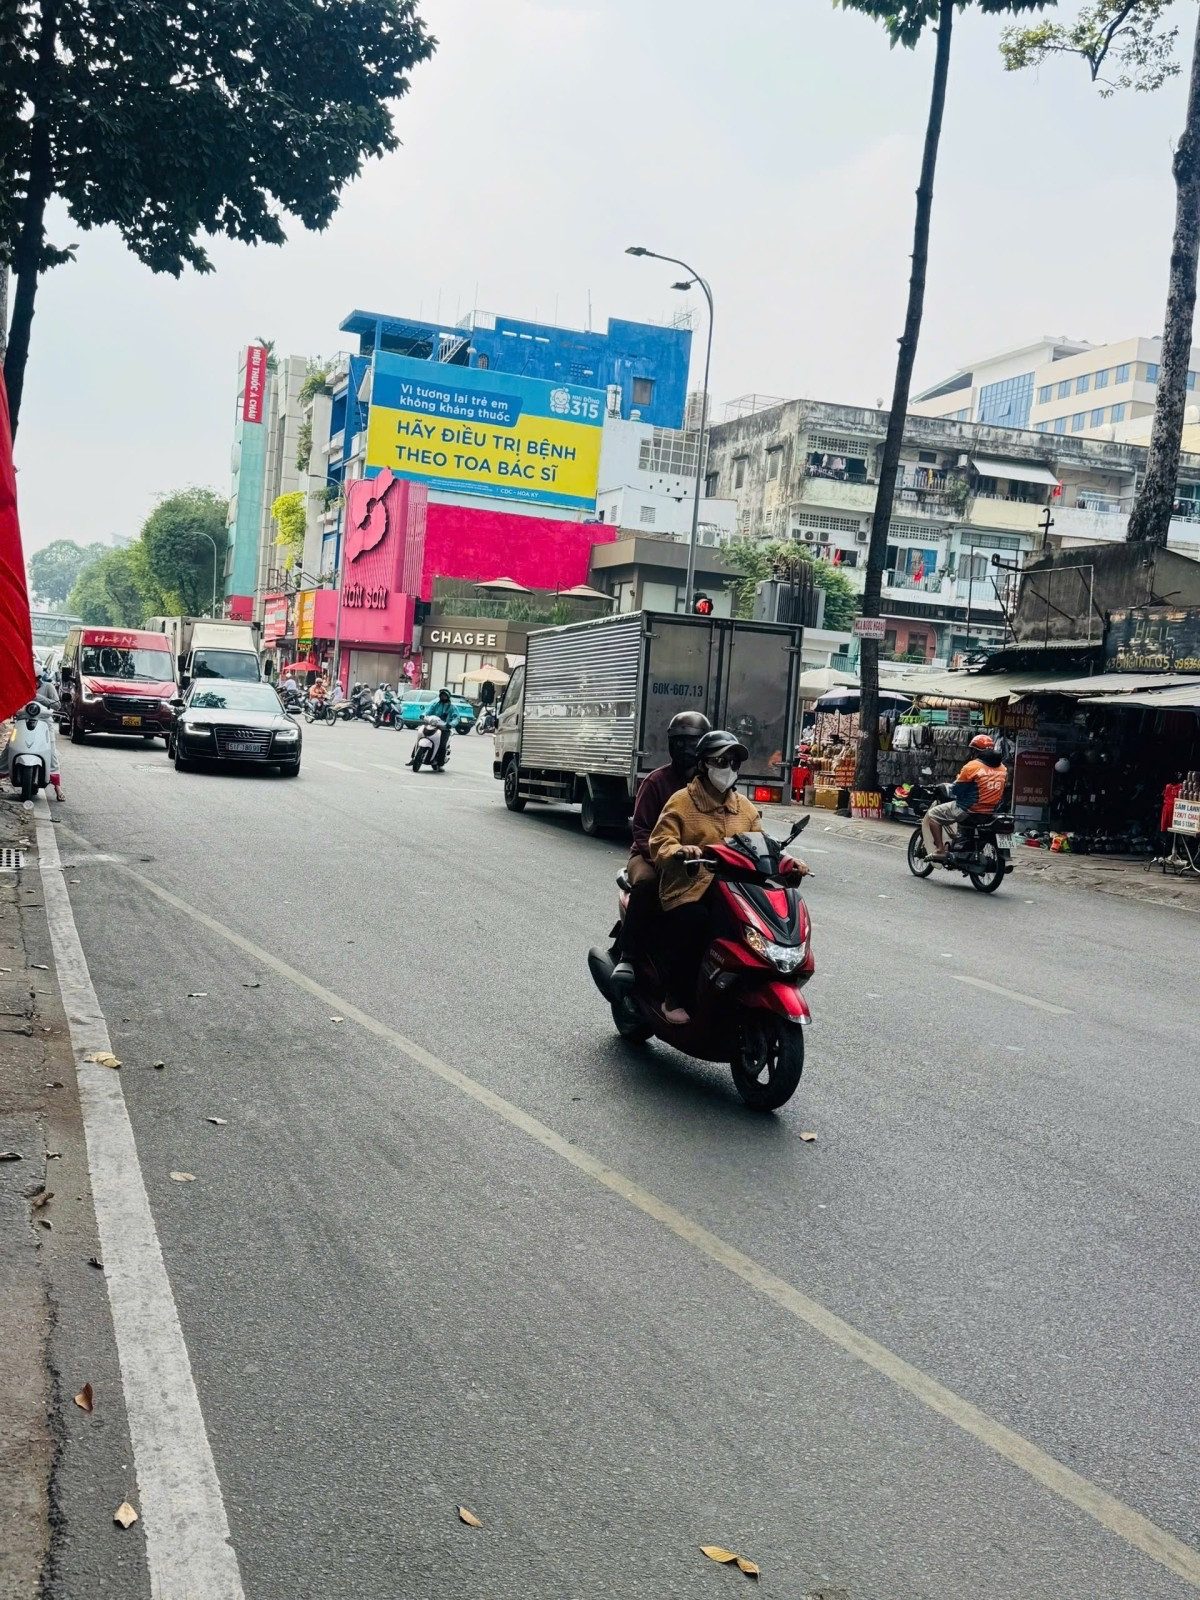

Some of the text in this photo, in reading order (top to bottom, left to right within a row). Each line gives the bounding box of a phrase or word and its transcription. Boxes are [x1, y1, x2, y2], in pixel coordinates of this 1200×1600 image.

[400, 395, 511, 422] không kháng thuốc
[416, 386, 451, 403] tương
[454, 393, 468, 404] lai
[471, 395, 488, 407] trẻ
[491, 401, 508, 410] em
[570, 400, 599, 419] 315
[397, 418, 576, 461] HÃY ĐIỀU TRỊ BỆNH
[395, 445, 559, 482] THEO TOA BÁC SĨ
[430, 630, 497, 646] CHAGEE
[652, 682, 703, 697] 60K-607.13
